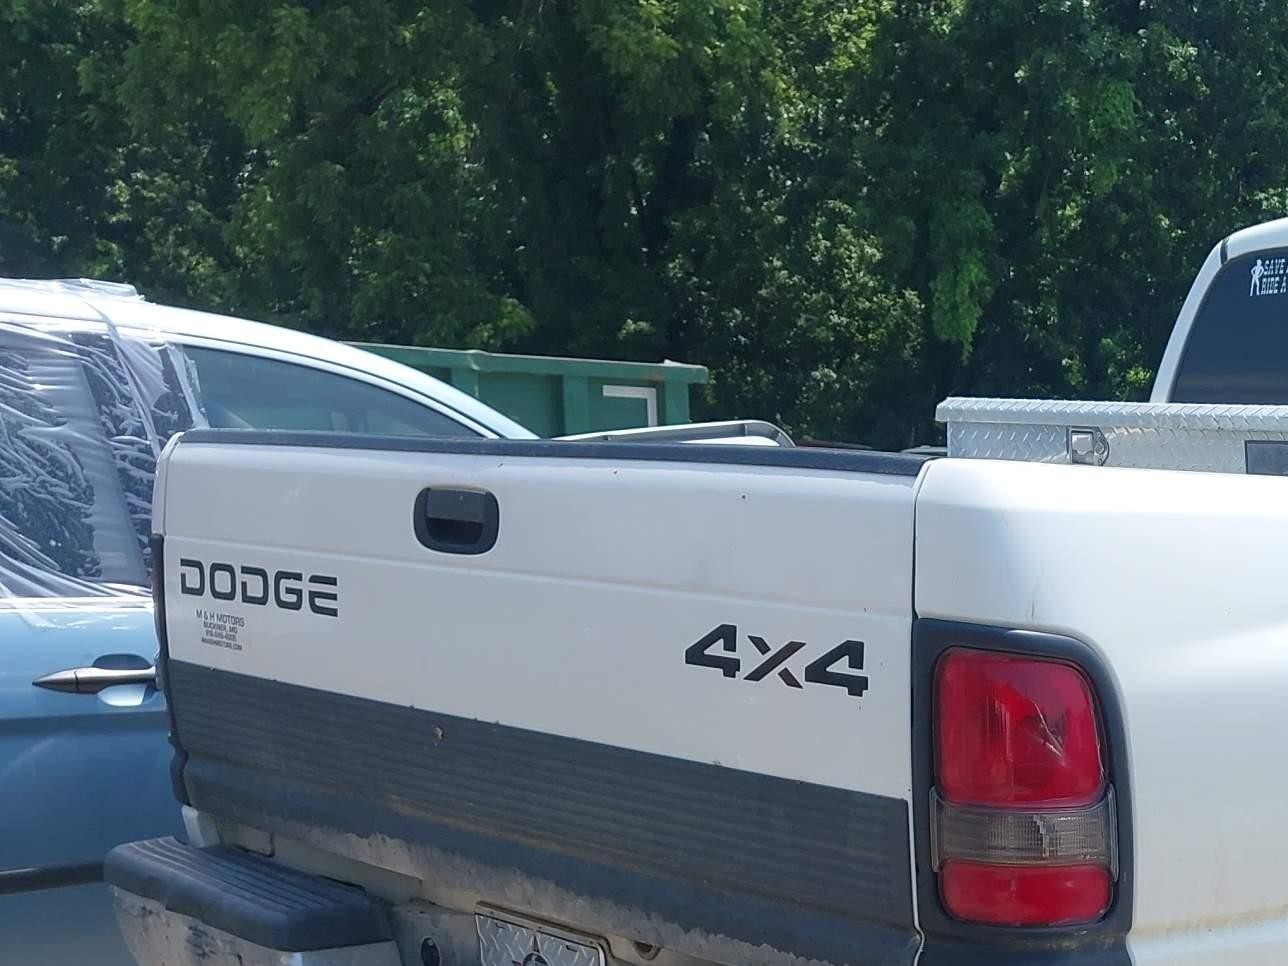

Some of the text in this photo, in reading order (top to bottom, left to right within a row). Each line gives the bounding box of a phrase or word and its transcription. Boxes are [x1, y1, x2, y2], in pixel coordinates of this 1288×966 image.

[1263, 257, 1285, 275] SAVE
[1260, 276, 1280, 295] RIDE
[1280, 275, 1287, 293] A
[180, 558, 338, 617] DODGE
[216, 612, 245, 628] MOTORS
